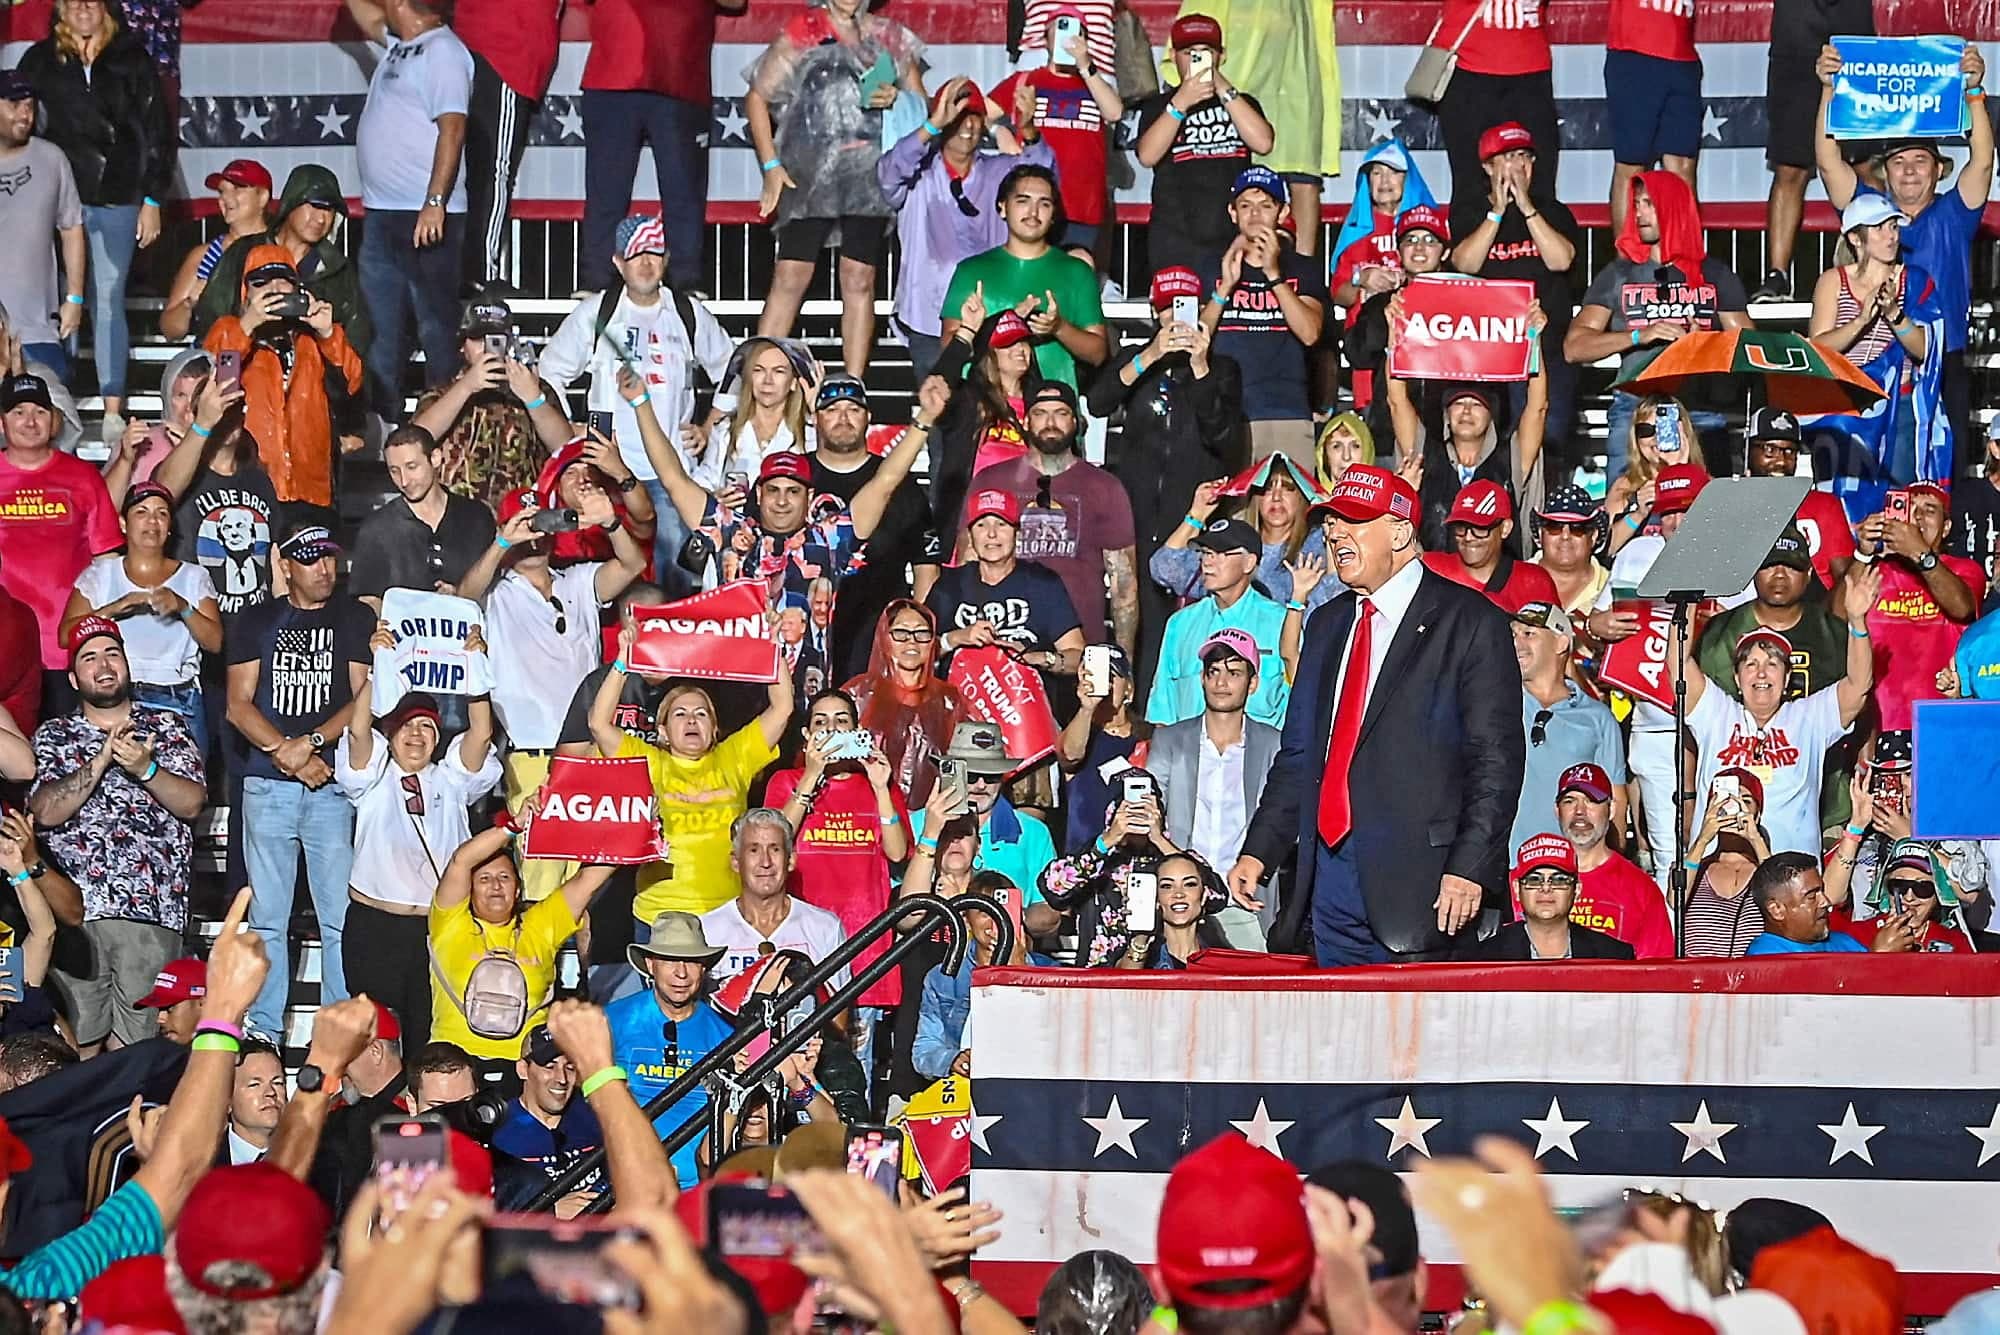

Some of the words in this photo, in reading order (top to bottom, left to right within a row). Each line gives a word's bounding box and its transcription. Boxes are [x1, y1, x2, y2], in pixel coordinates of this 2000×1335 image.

[1838, 62, 1958, 77] NICARAGUANS
[1876, 78, 1916, 92] FOR
[1854, 93, 1941, 113] TRUMP!
[1646, 304, 1695, 318] 2024
[1404, 312, 1526, 343] AGAIN!
[219, 489, 238, 506] BE
[1344, 485, 1376, 502] AGAIN
[643, 612, 771, 639] AGAIN!
[1638, 603, 1676, 689] AGAI
[272, 651, 311, 670] LET'S
[313, 651, 333, 670] GO
[272, 670, 332, 686] BRANDON
[400, 661, 465, 690] TUMP
[1000, 658, 1036, 705] TEXT
[979, 664, 1022, 726] TRUMP
[541, 794, 654, 823] AGAIN
[824, 820, 853, 829] SAVE
[803, 828, 875, 842] AMERICA
[1570, 905, 1593, 914] AVE
[1569, 915, 1616, 929] RICA
[635, 1063, 687, 1078] AMER
